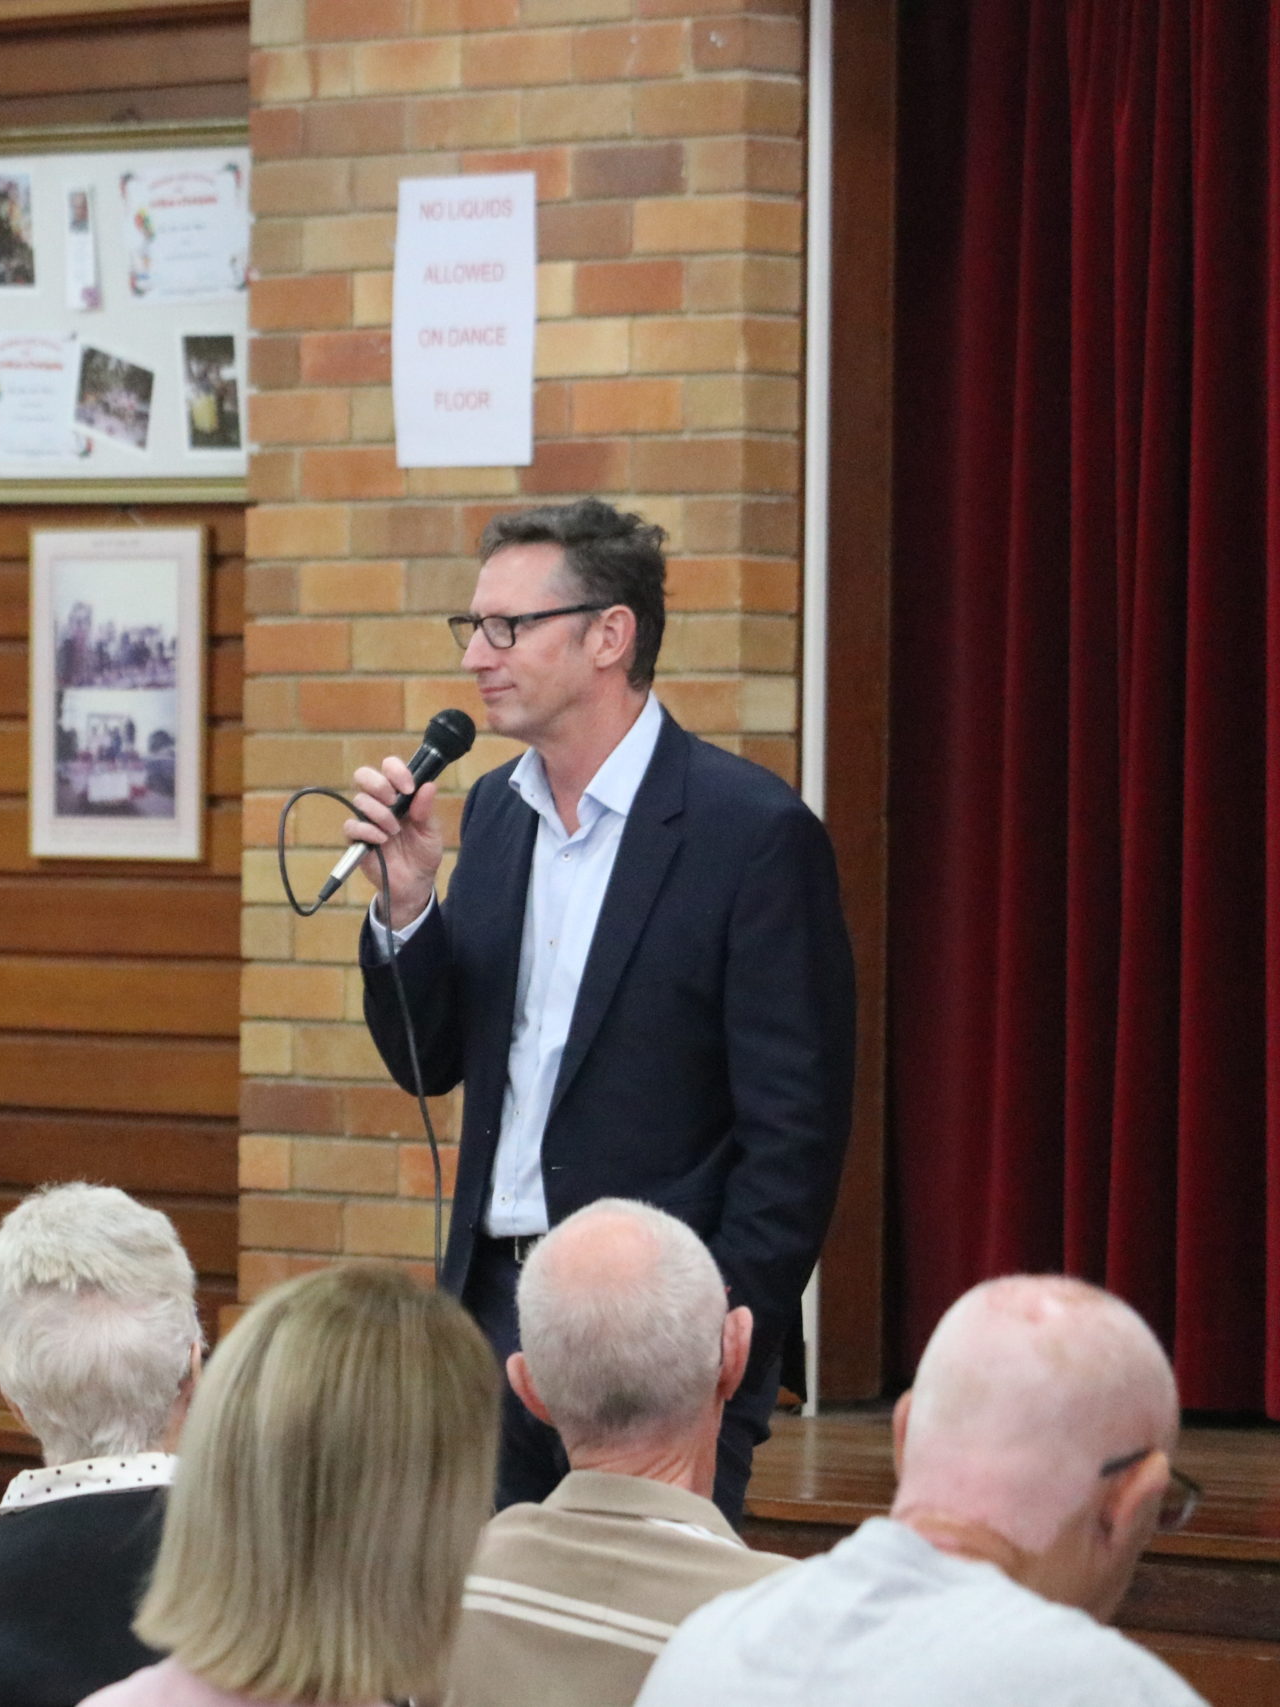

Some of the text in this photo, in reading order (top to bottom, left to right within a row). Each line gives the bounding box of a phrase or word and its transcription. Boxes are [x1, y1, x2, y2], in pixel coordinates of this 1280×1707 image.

[419, 197, 514, 222] NO LIQUIDS
[424, 262, 505, 284] ALLOWED
[418, 325, 508, 349] ON DANCE
[433, 390, 491, 411] FLOOR
